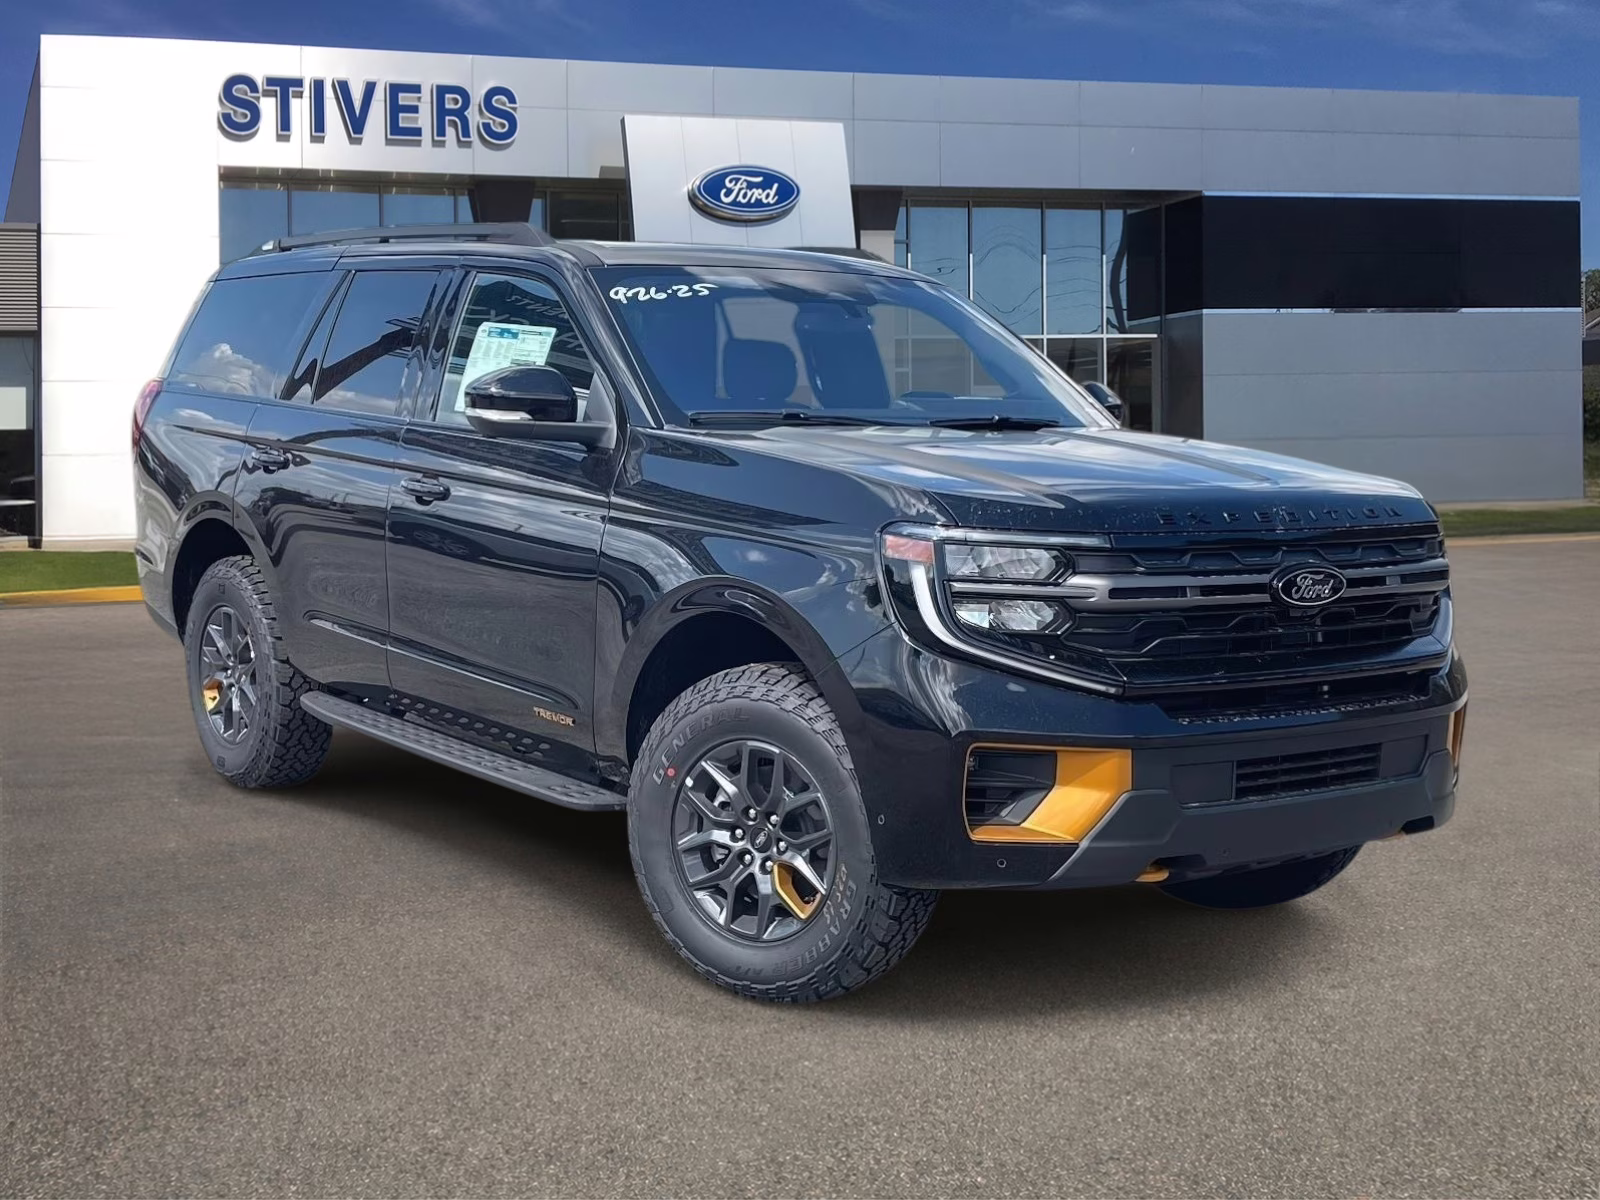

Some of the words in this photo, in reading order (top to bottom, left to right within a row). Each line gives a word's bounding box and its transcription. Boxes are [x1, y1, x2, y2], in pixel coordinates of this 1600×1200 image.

[218, 74, 518, 149] STIVERS
[720, 174, 779, 204] Ford
[1155, 506, 1402, 526] EXPEDITION
[1291, 573, 1333, 600] Ford
[533, 706, 575, 727] TREMOR
[652, 708, 750, 785] GENERAL
[773, 880, 857, 977] GRABBER
